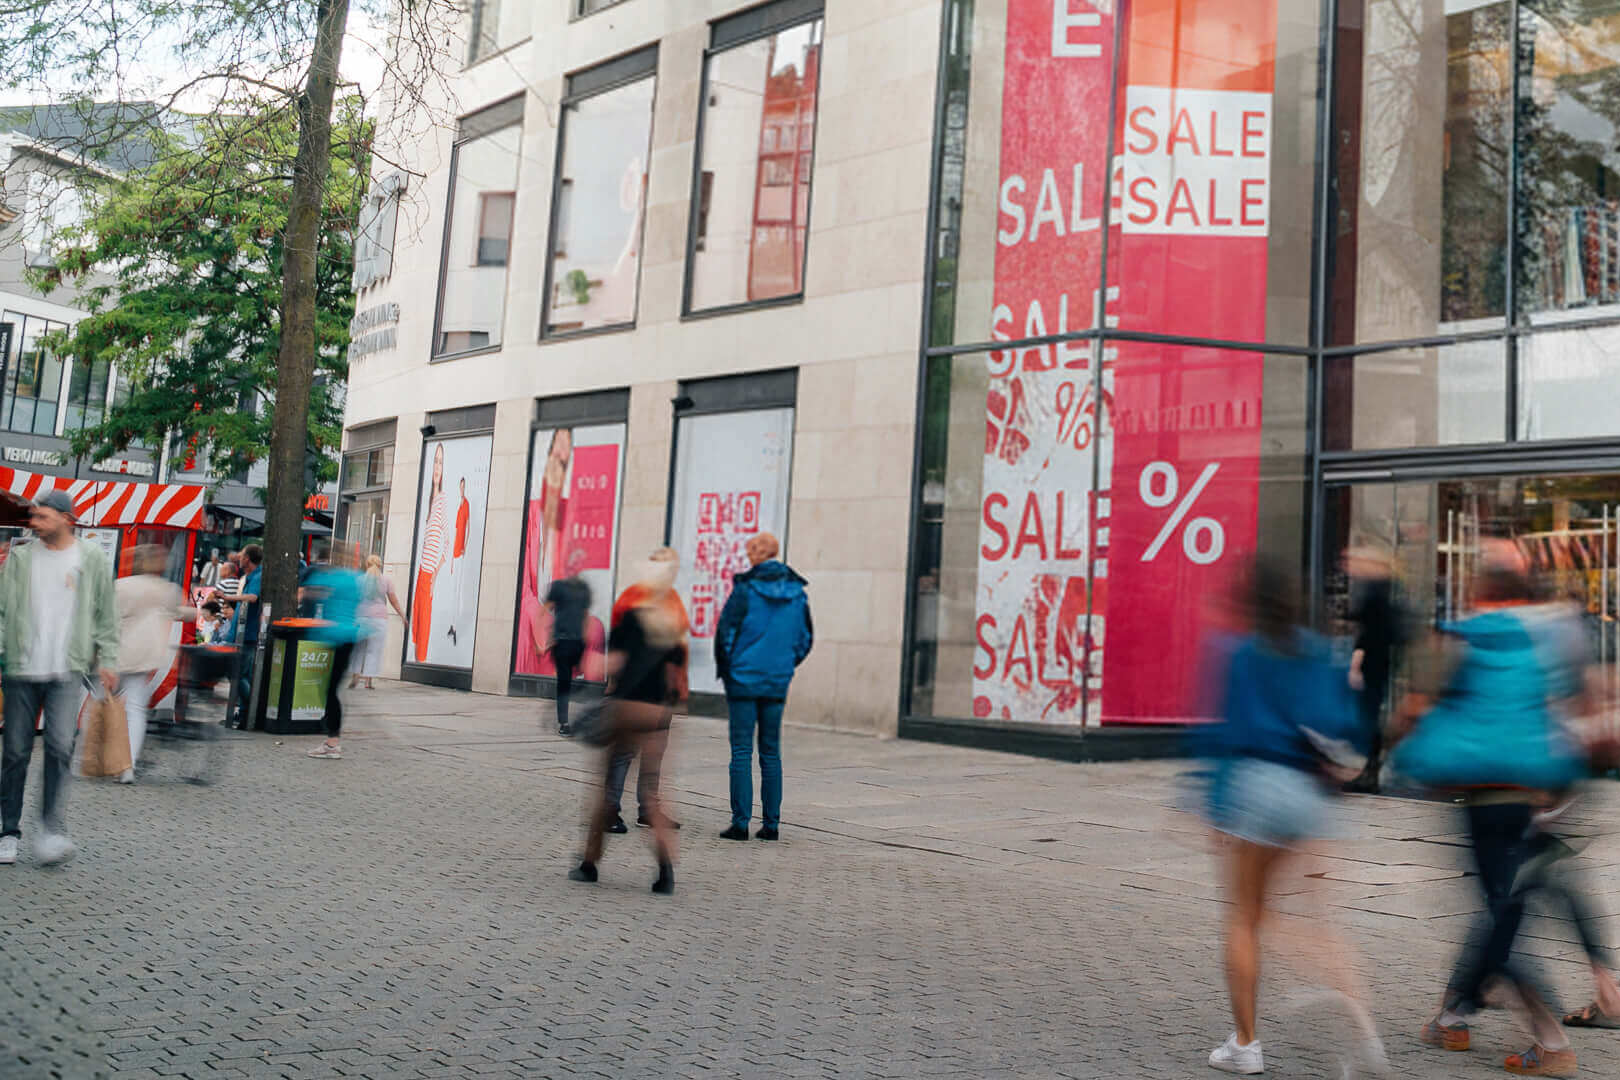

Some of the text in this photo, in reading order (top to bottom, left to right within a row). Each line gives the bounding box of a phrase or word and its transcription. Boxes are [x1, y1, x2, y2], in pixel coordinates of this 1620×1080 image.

[1128, 105, 1266, 158] SALE
[1127, 176, 1266, 227] SALE
[984, 286, 1120, 375] SALE
[1139, 461, 1225, 565] %
[301, 651, 329, 663] 24/7
